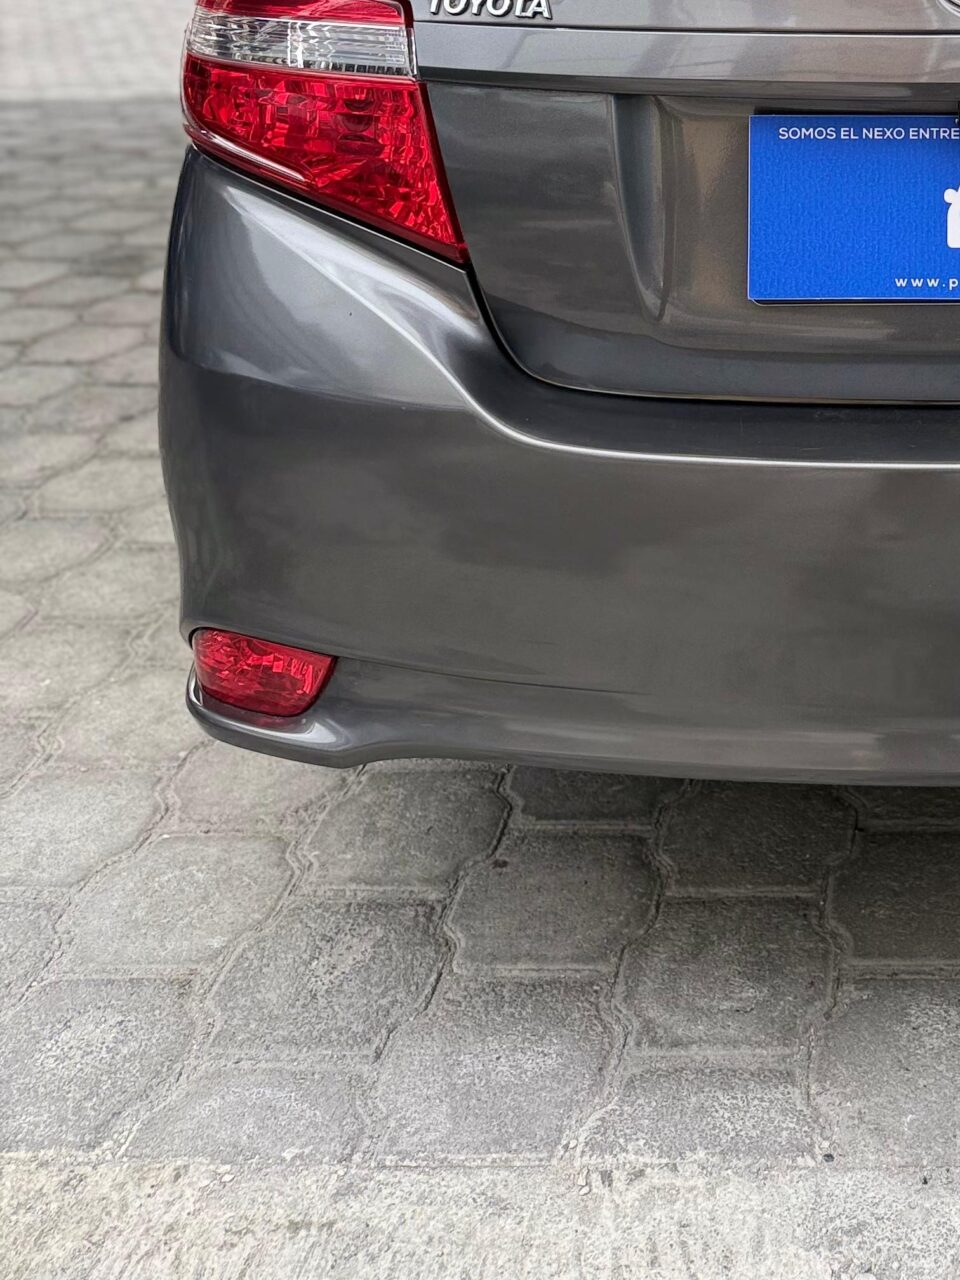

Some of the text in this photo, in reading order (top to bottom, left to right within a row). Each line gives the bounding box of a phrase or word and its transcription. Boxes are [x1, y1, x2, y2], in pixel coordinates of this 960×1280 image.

[778, 127, 836, 140] SOMOS
[840, 127, 859, 140] EL
[862, 127, 905, 140] NEXO
[909, 127, 960, 140] ENTRE
